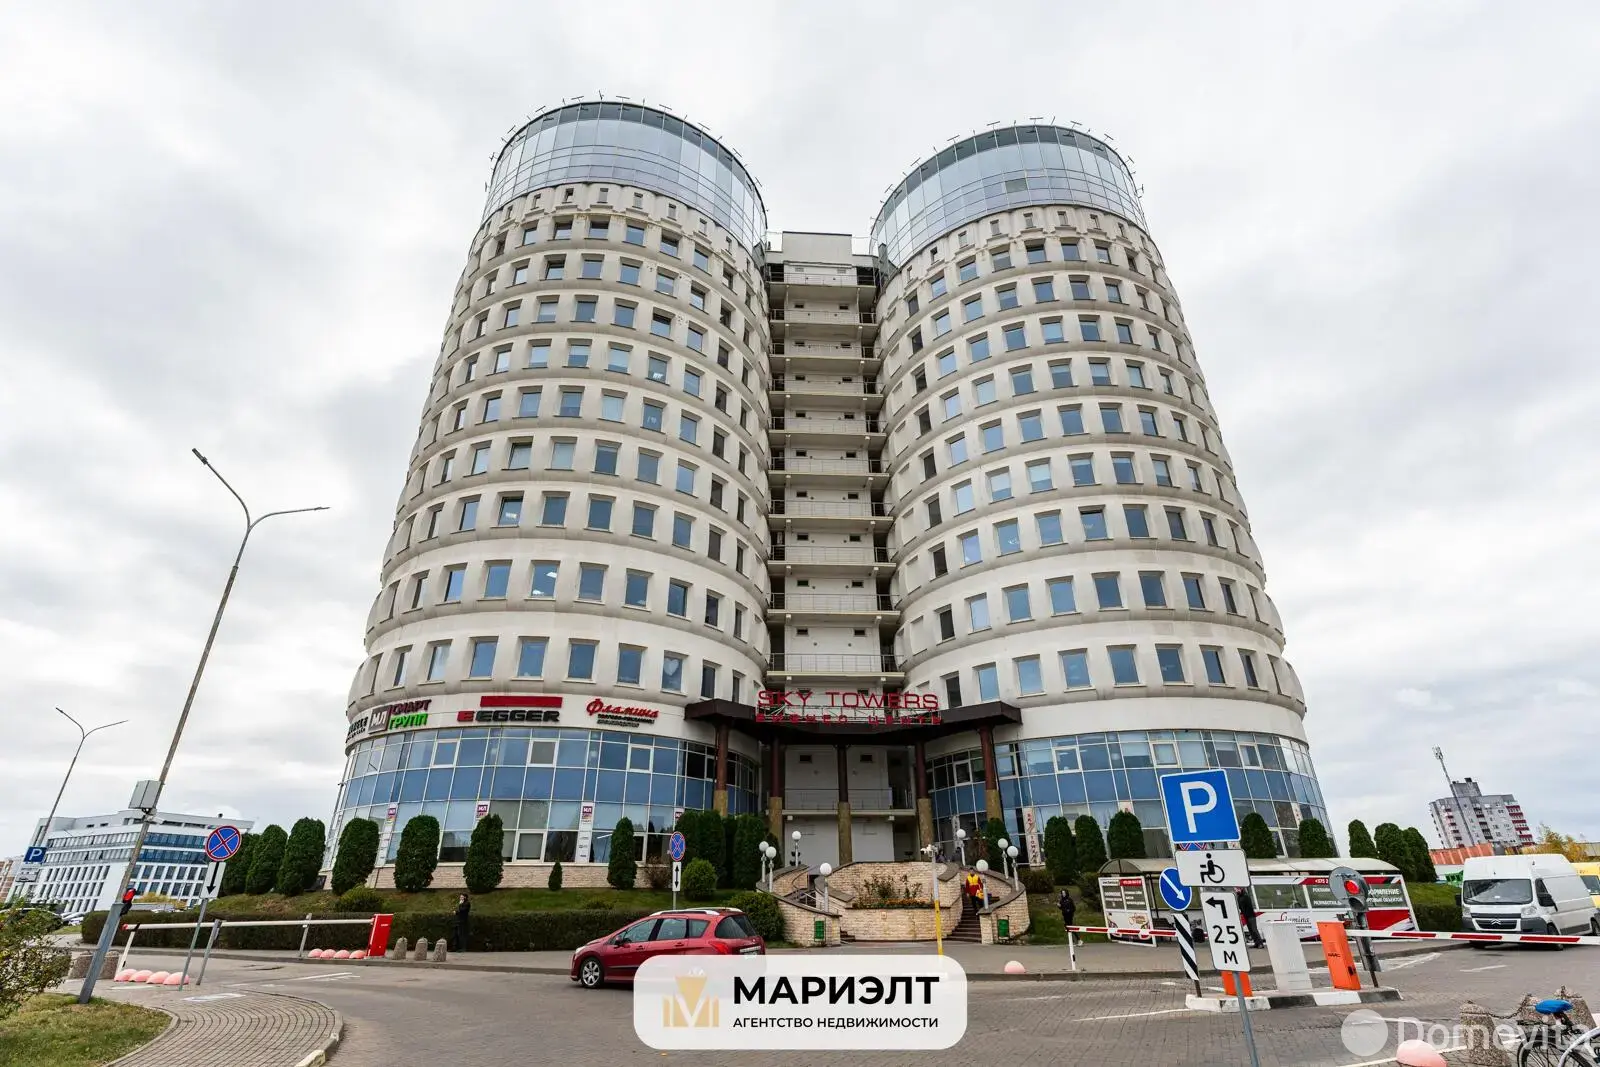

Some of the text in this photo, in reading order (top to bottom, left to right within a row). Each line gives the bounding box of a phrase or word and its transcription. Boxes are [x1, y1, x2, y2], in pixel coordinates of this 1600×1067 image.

[391, 699, 432, 715] СМАРТ
[757, 690, 938, 709] SKY TOWERS
[389, 713, 429, 730] ГРУПП
[476, 710, 560, 722] EGGER
[1180, 781, 1217, 833] P
[29, 849, 42, 860] P
[1213, 925, 1239, 944] 25
[1224, 951, 1238, 964] М
